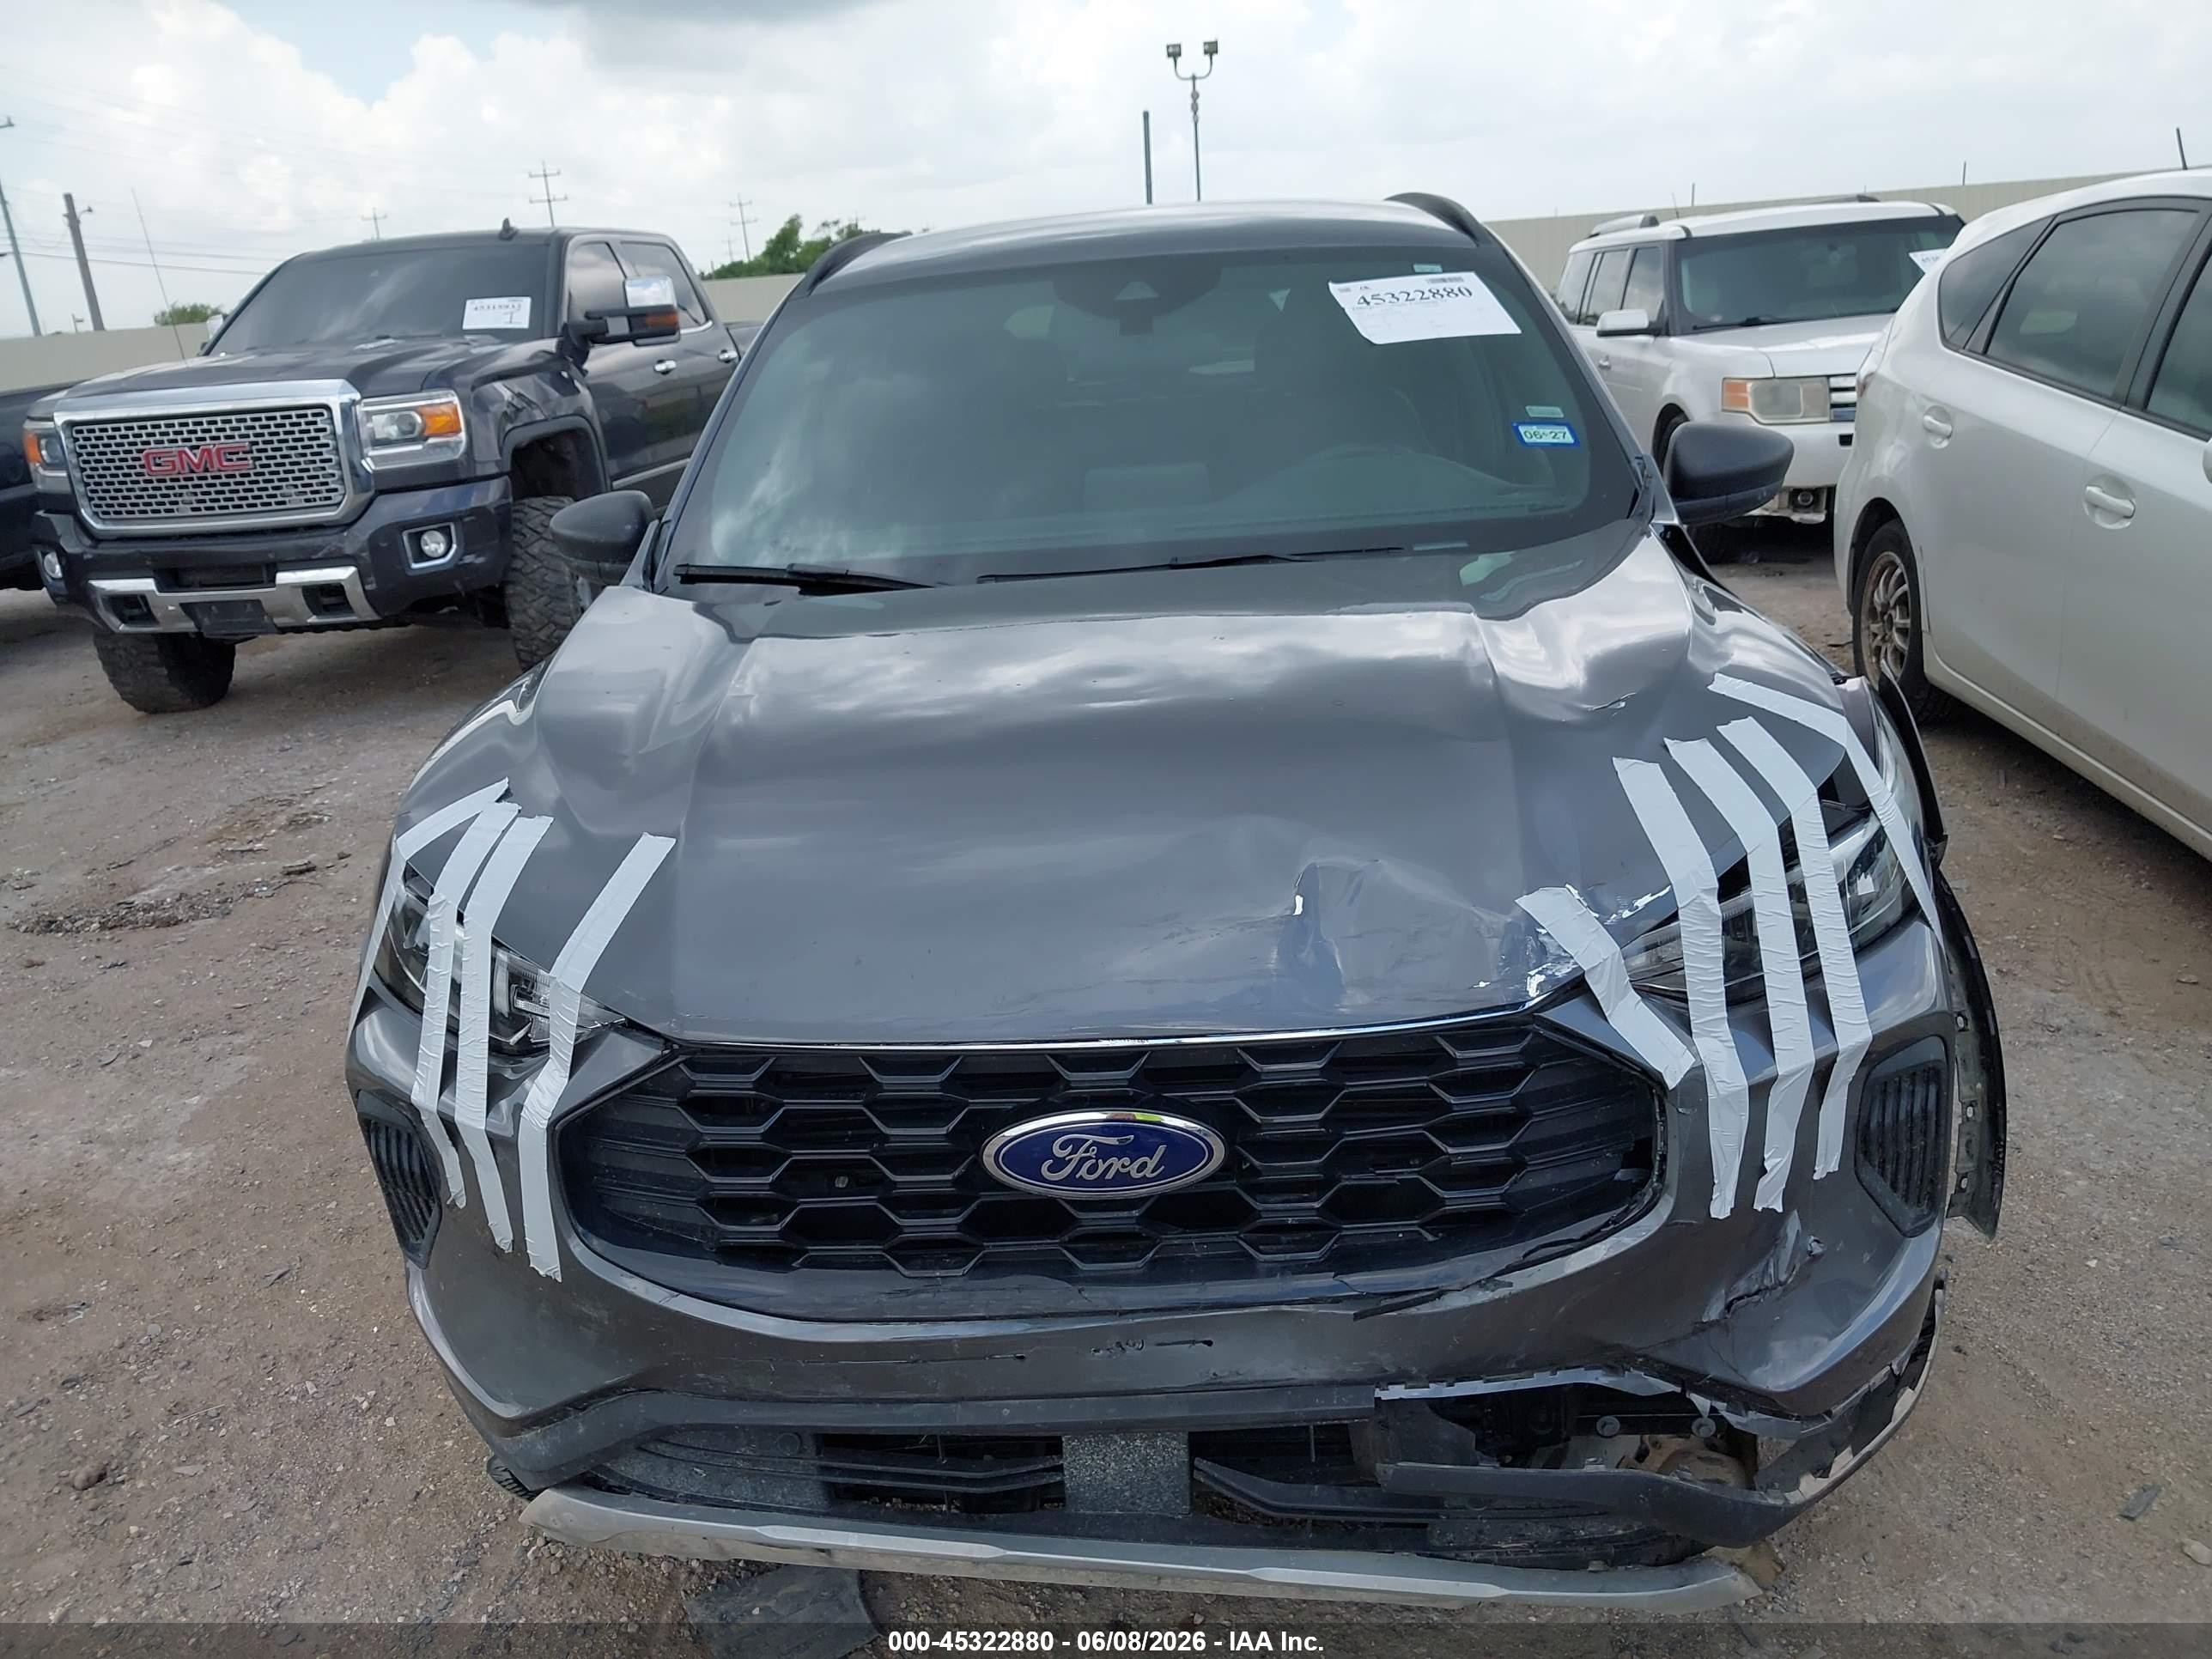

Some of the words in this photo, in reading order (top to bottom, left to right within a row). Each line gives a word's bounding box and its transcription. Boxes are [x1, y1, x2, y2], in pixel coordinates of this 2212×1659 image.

[1357, 286, 1474, 307] 45322880
[142, 442, 253, 476] GMC
[1041, 1133, 1167, 1182] Ford
